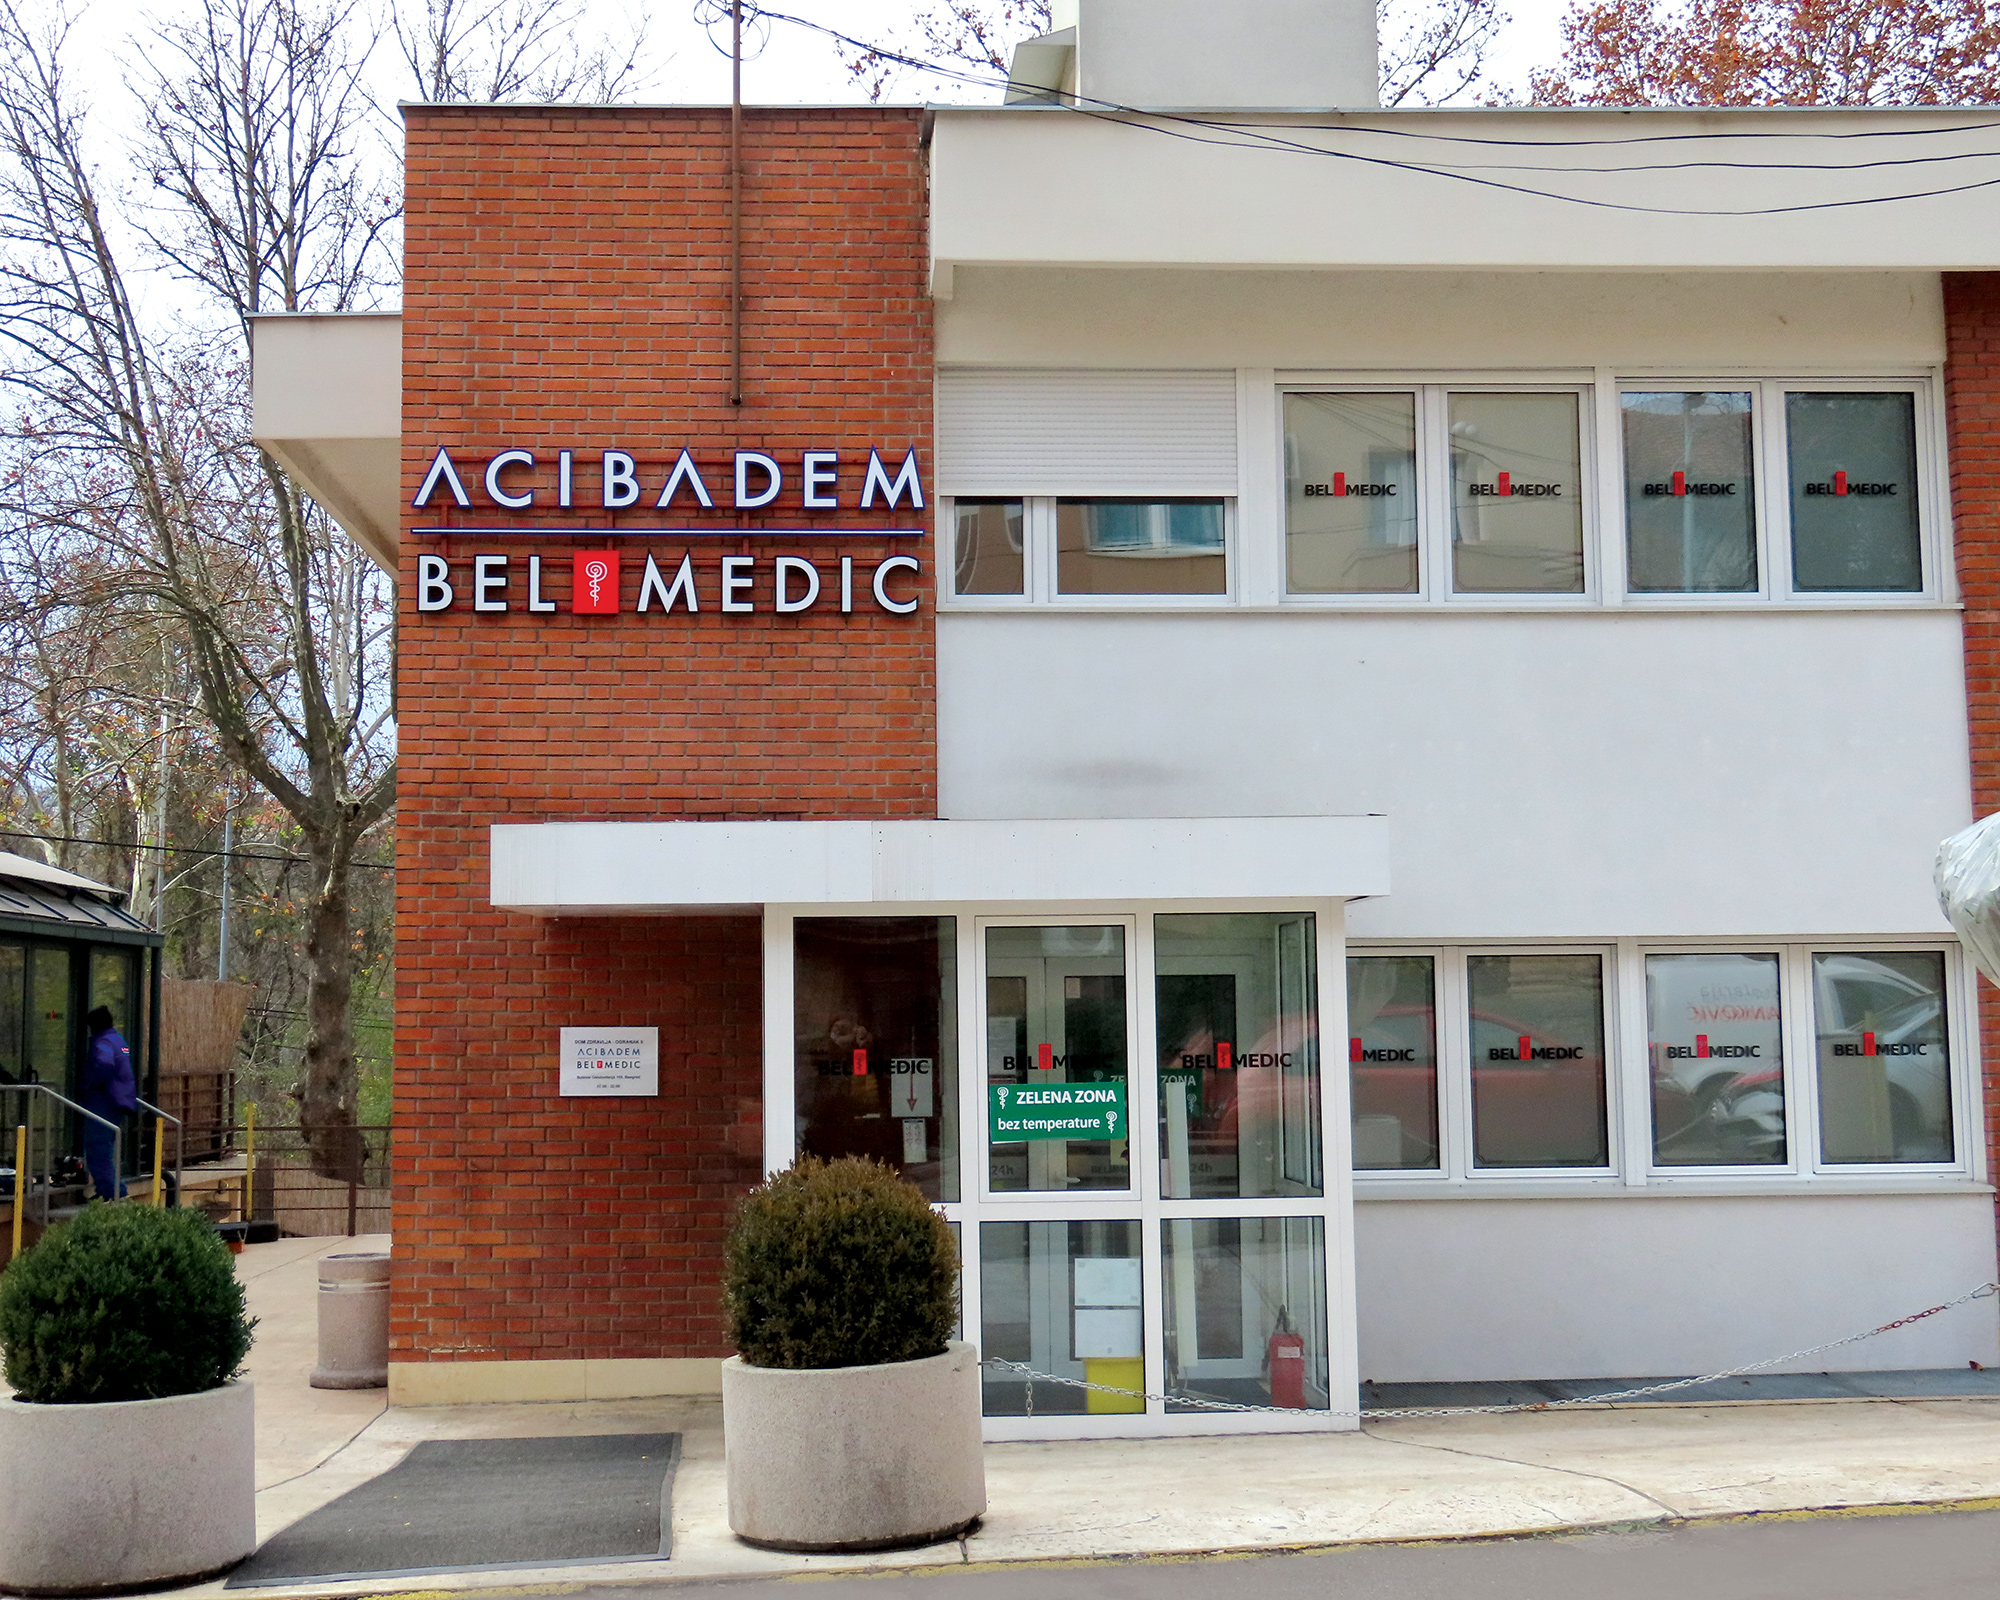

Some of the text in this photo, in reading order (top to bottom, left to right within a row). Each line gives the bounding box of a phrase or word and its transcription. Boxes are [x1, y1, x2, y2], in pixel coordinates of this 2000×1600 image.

[412, 445, 925, 510] ACIBADEM
[1304, 484, 1396, 496] BEL MEDIC
[1470, 484, 1561, 496] BEL MEDIC
[1644, 483, 1736, 495] BEL MEDIC
[1806, 483, 1897, 495] BEL MEDIC
[417, 550, 919, 614] BEL MEDIC
[577, 1048, 640, 1056] ACIBADEM
[1363, 1049, 1415, 1062] MEDIC
[1489, 1047, 1583, 1061] BEL MEDIC
[1667, 1045, 1760, 1059] BEL MEDIC
[1834, 1043, 1927, 1056] BEL MEDIC
[577, 1061, 641, 1069] BEL MEDIC
[1003, 1055, 1113, 1070] BL MIC
[1182, 1053, 1292, 1069] BEL MEDIC
[1016, 1089, 1117, 1105] ZELENA ZONA
[998, 1116, 1101, 1132] bez temperature
